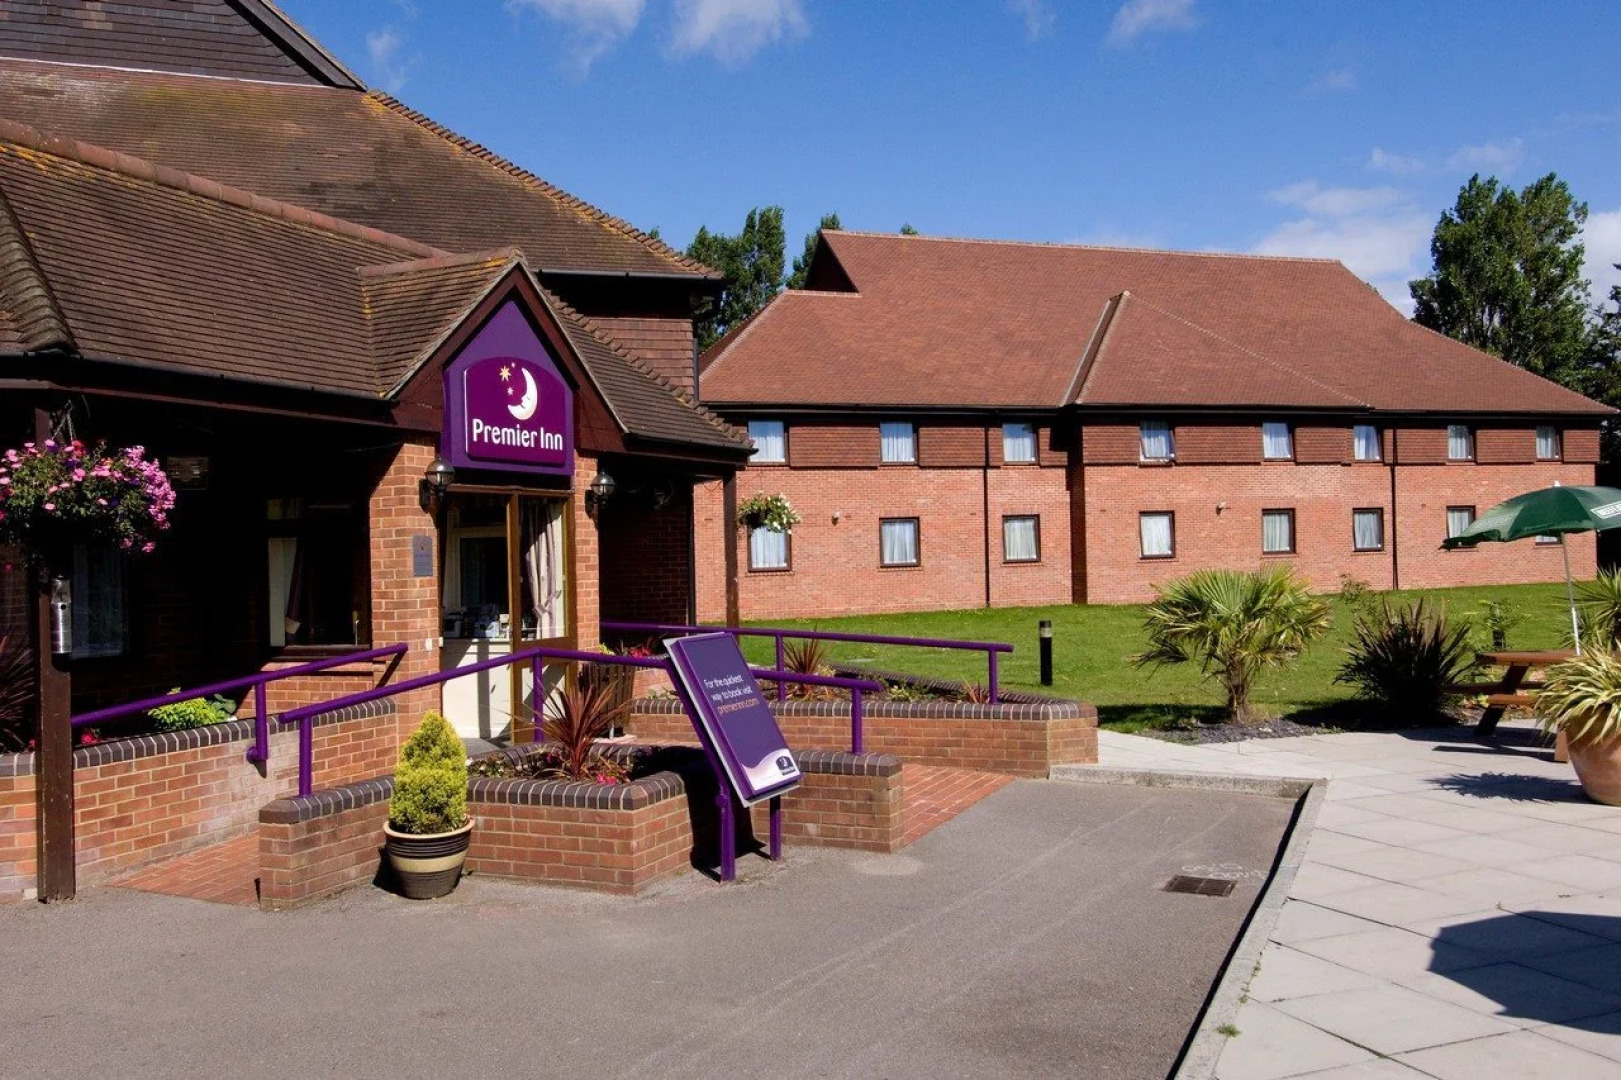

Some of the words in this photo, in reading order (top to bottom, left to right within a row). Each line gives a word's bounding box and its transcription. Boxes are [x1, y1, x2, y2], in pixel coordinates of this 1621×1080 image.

[472, 418, 538, 448] Premier
[540, 427, 563, 451] Inn
[704, 679, 715, 688] For
[714, 677, 724, 687] the
[723, 674, 744, 688] quickest
[711, 694, 723, 702] way
[727, 688, 743, 698] book
[742, 685, 753, 695] visit
[717, 698, 759, 715] premierinn.com
